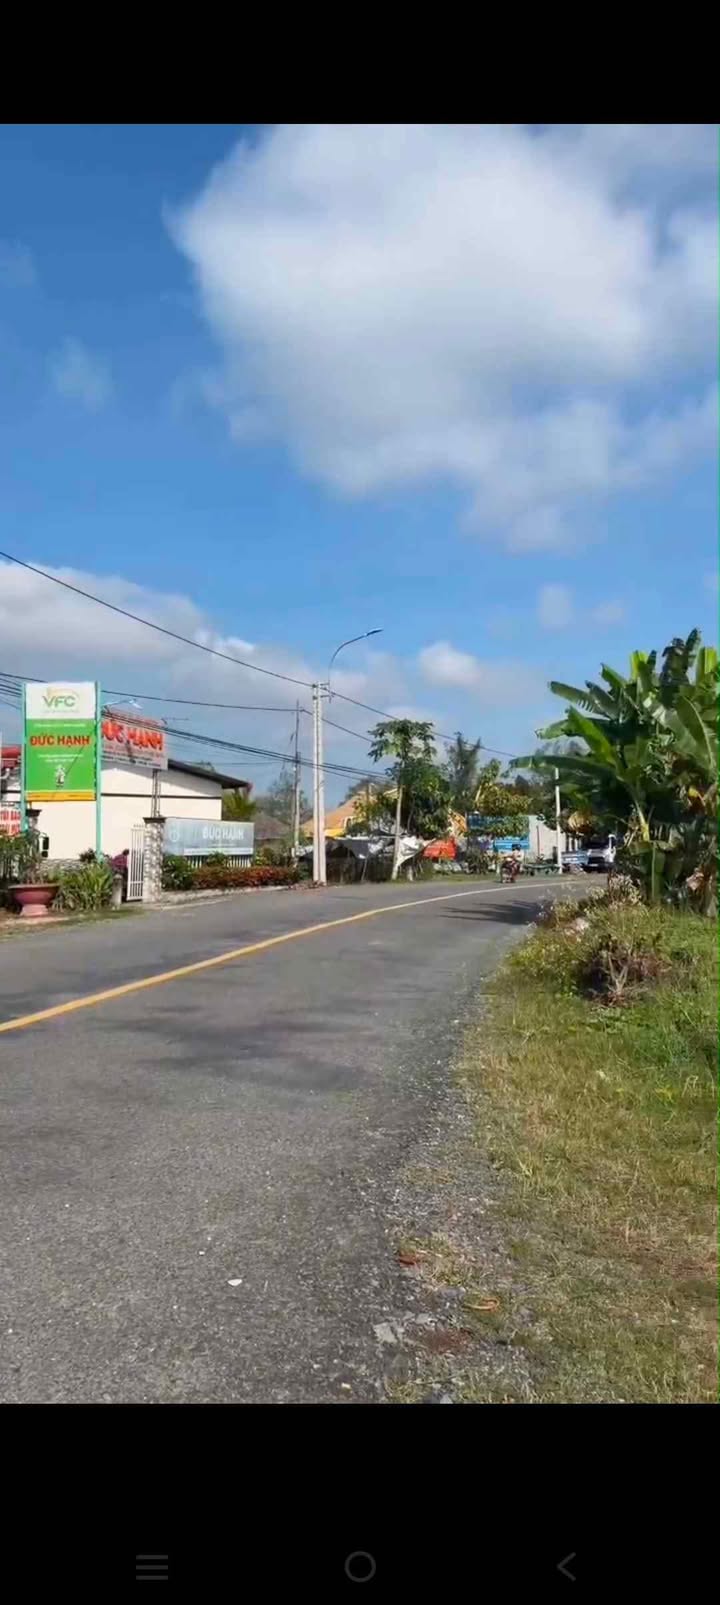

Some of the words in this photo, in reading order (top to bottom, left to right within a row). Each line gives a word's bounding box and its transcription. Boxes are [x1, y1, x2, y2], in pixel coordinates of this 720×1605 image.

[42, 695, 76, 708] VFC
[30, 732, 55, 746] ĐỨC
[57, 735, 90, 748] HẠNH
